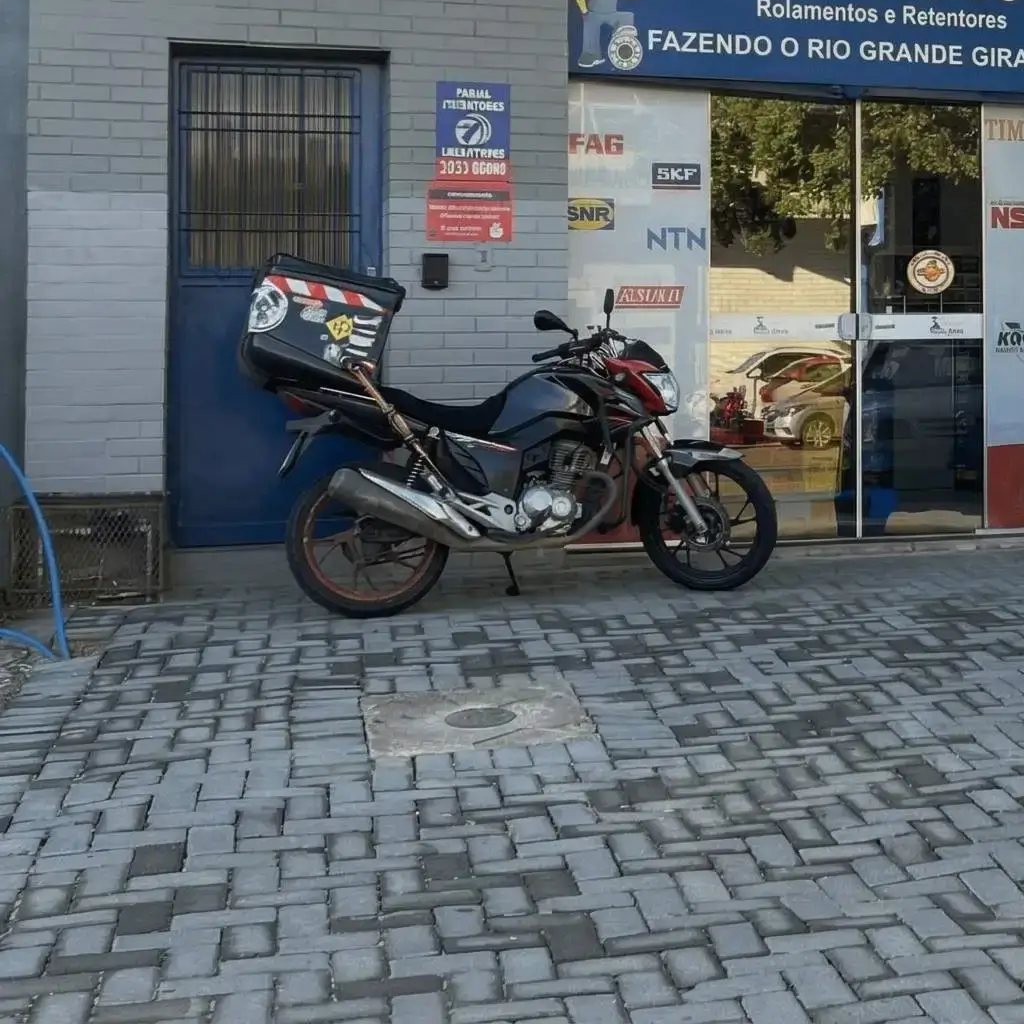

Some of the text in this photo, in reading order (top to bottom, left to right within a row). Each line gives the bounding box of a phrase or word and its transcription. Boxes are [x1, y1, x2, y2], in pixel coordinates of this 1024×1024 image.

[884, 7, 896, 24] e
[902, 5, 1008, 30] Retentores
[648, 29, 772, 57] FAZENDO
[780, 36, 799, 59] O
[808, 38, 851, 60] RIO
[860, 42, 963, 66] GRANDE
[568, 133, 624, 155] FAG
[656, 167, 697, 181] SKF
[568, 205, 611, 222] SNR
[647, 228, 706, 251] NTN
